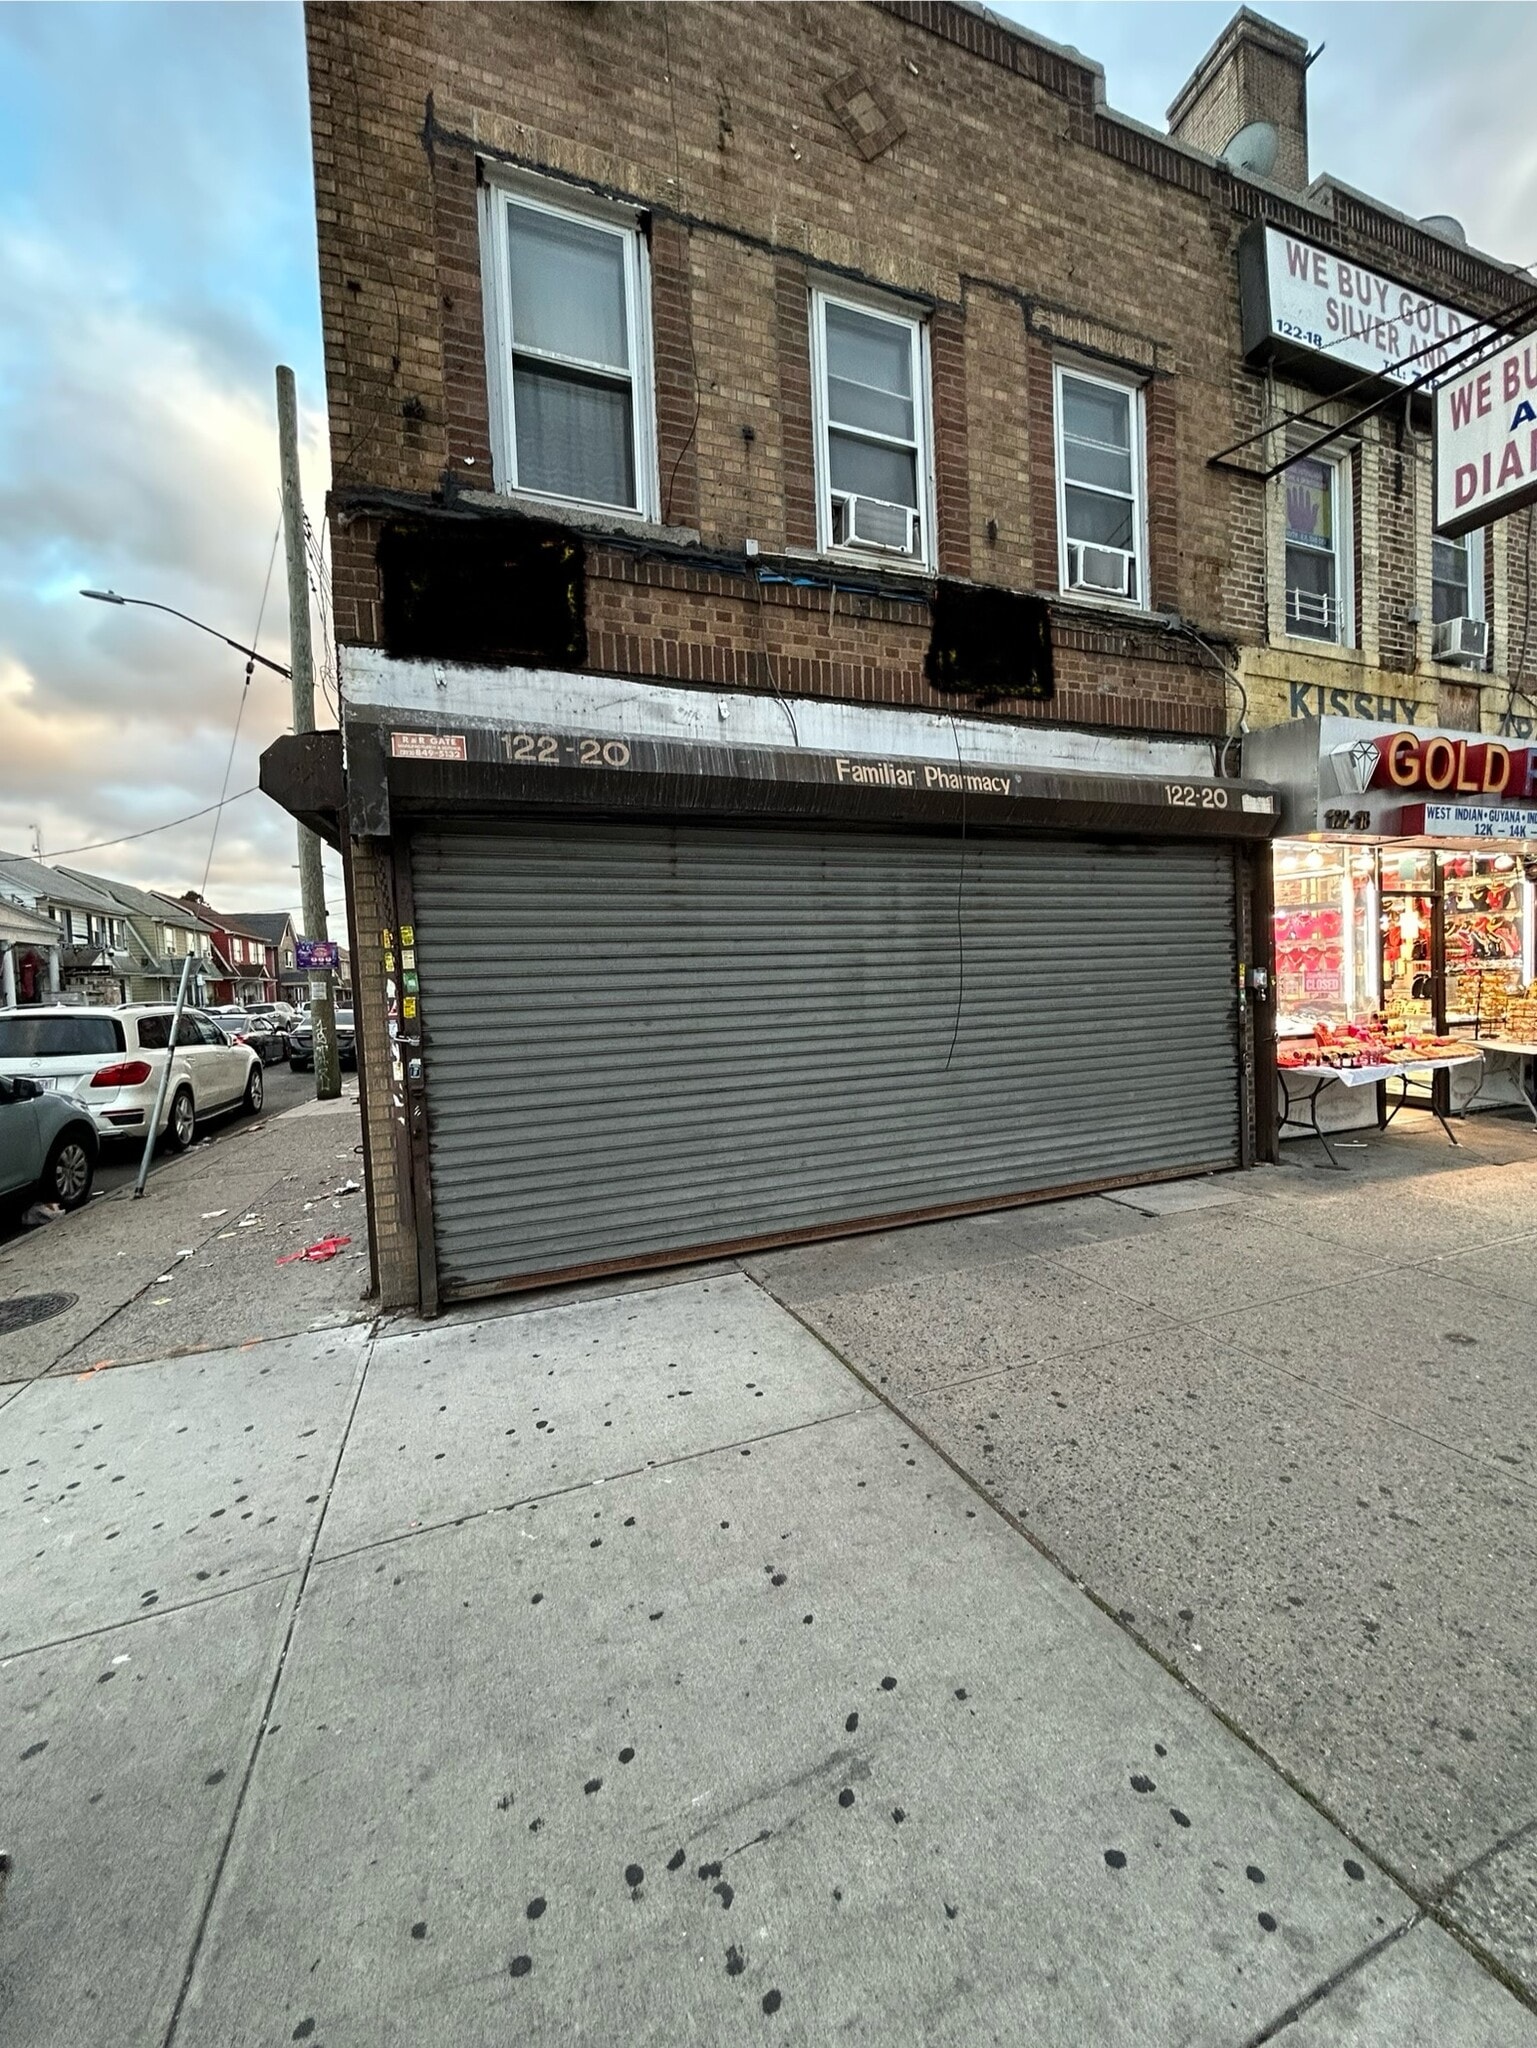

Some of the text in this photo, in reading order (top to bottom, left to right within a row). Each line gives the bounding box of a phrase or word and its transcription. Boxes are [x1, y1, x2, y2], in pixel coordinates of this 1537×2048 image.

[1286, 240, 1329, 290] WE
[1338, 262, 1389, 315] BUY
[1399, 292, 1462, 345] GOLD
[1276, 318, 1323, 348] 122-18
[1326, 296, 1400, 358] SILVER
[1450, 370, 1492, 432] WE
[1290, 681, 1420, 726] KISSHY
[429, 737, 456, 746] GATE
[836, 757, 1012, 796] Familiar Pharmacy
[1388, 731, 1511, 793] GOLD
[1164, 784, 1229, 809] 122-20
[1427, 806, 1451, 820] WEST
[1455, 808, 1483, 821] INDIAN
[1489, 810, 1520, 823] GUYANA
[1475, 823, 1526, 837] 12K 14K
[1306, 978, 1339, 991] CLOSED
